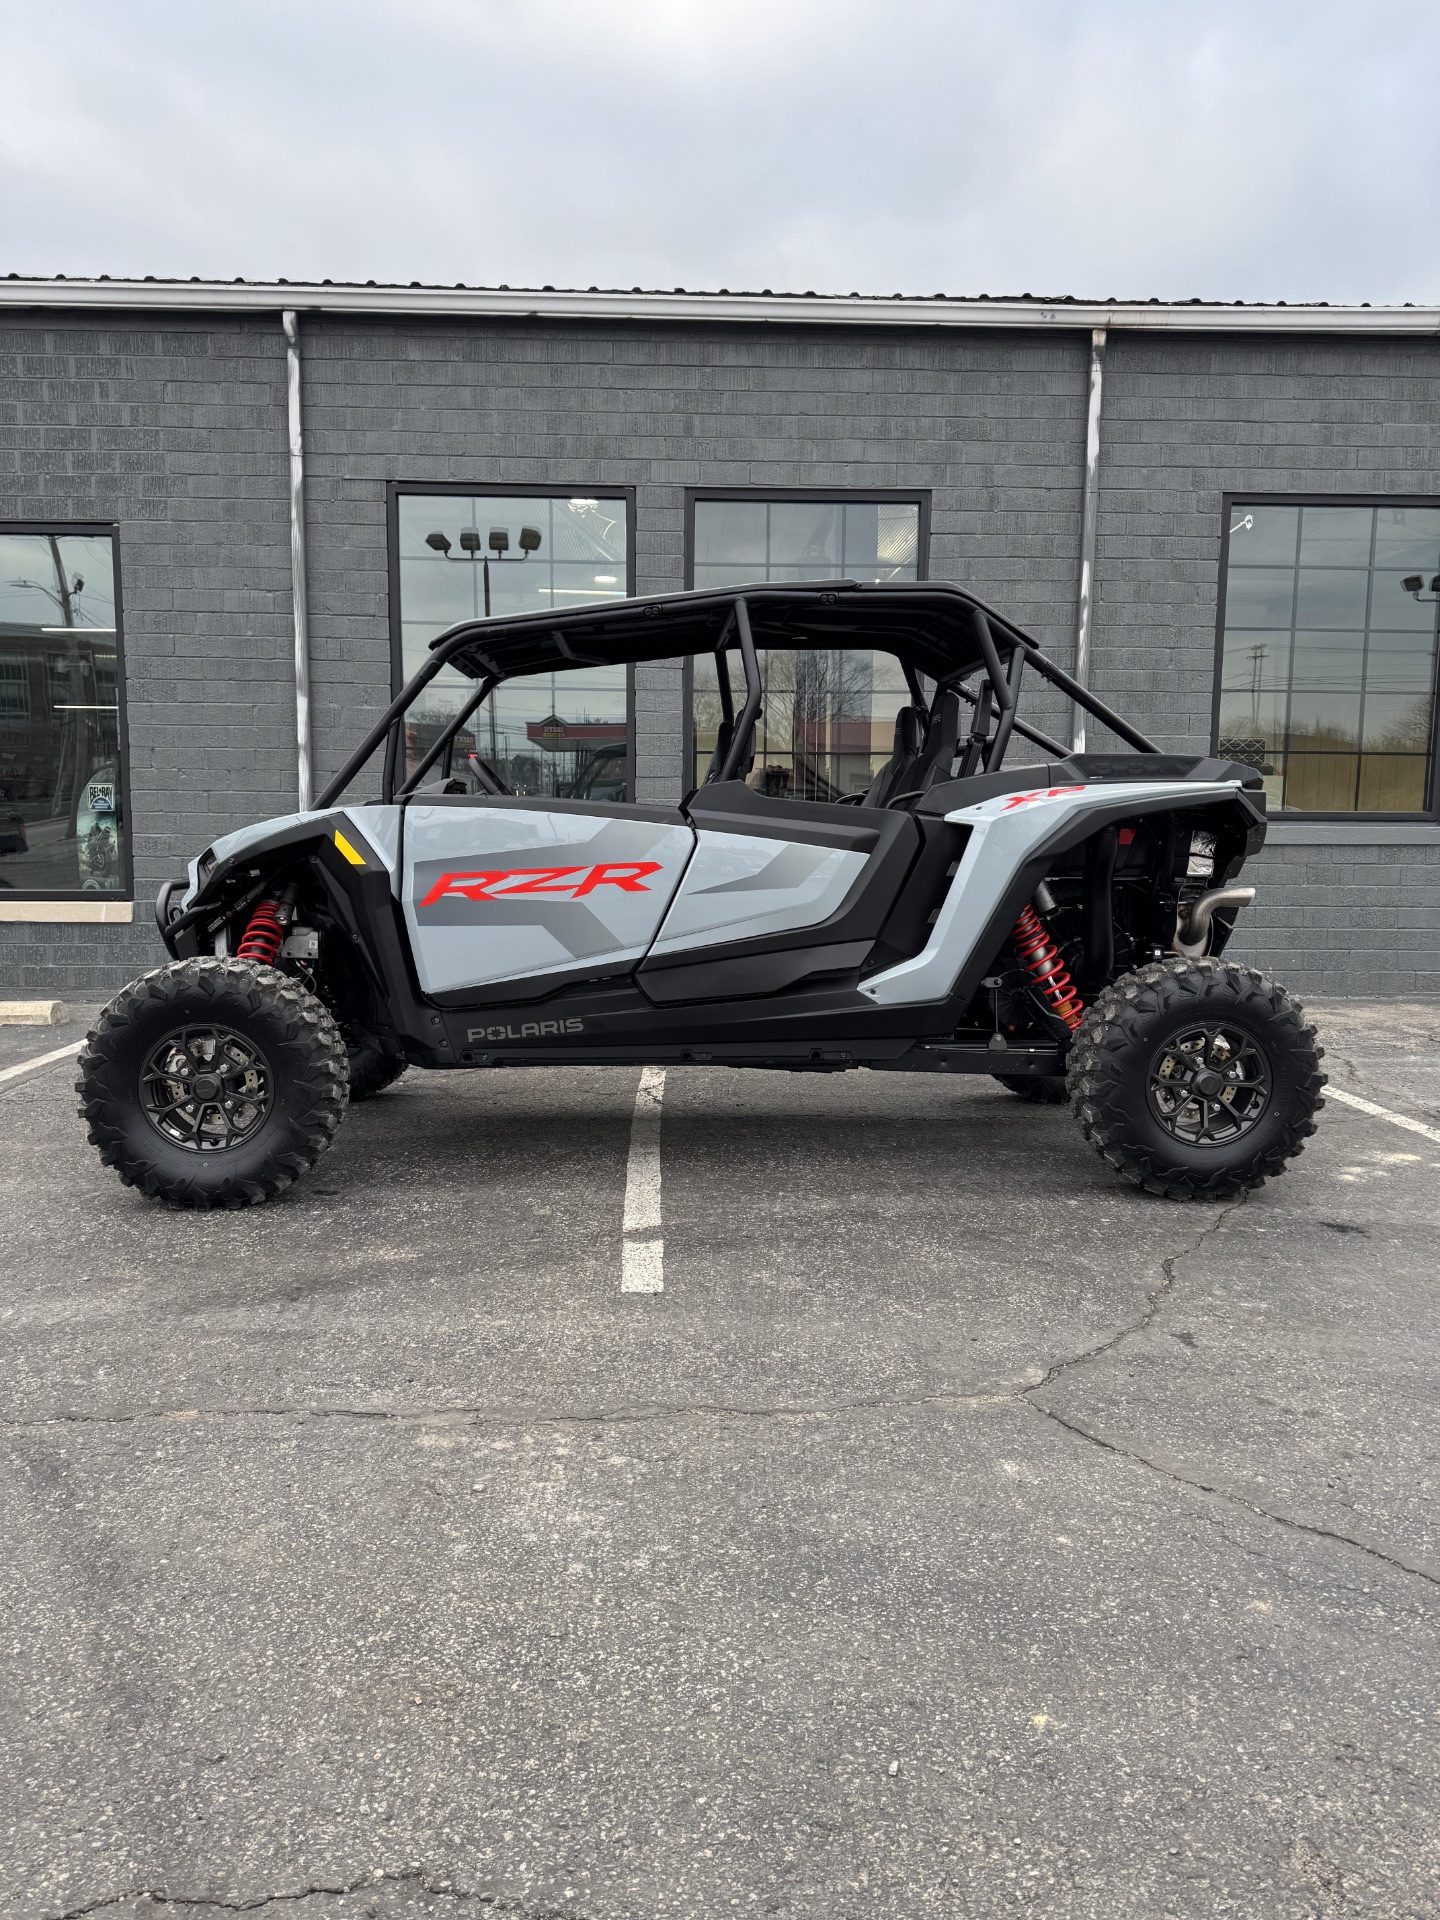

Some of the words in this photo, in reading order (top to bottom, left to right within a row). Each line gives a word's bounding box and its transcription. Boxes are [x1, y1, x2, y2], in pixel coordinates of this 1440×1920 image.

[1000, 785, 1086, 811] XP
[418, 861, 664, 908] RZR
[467, 1018, 584, 1043] POLARIS
